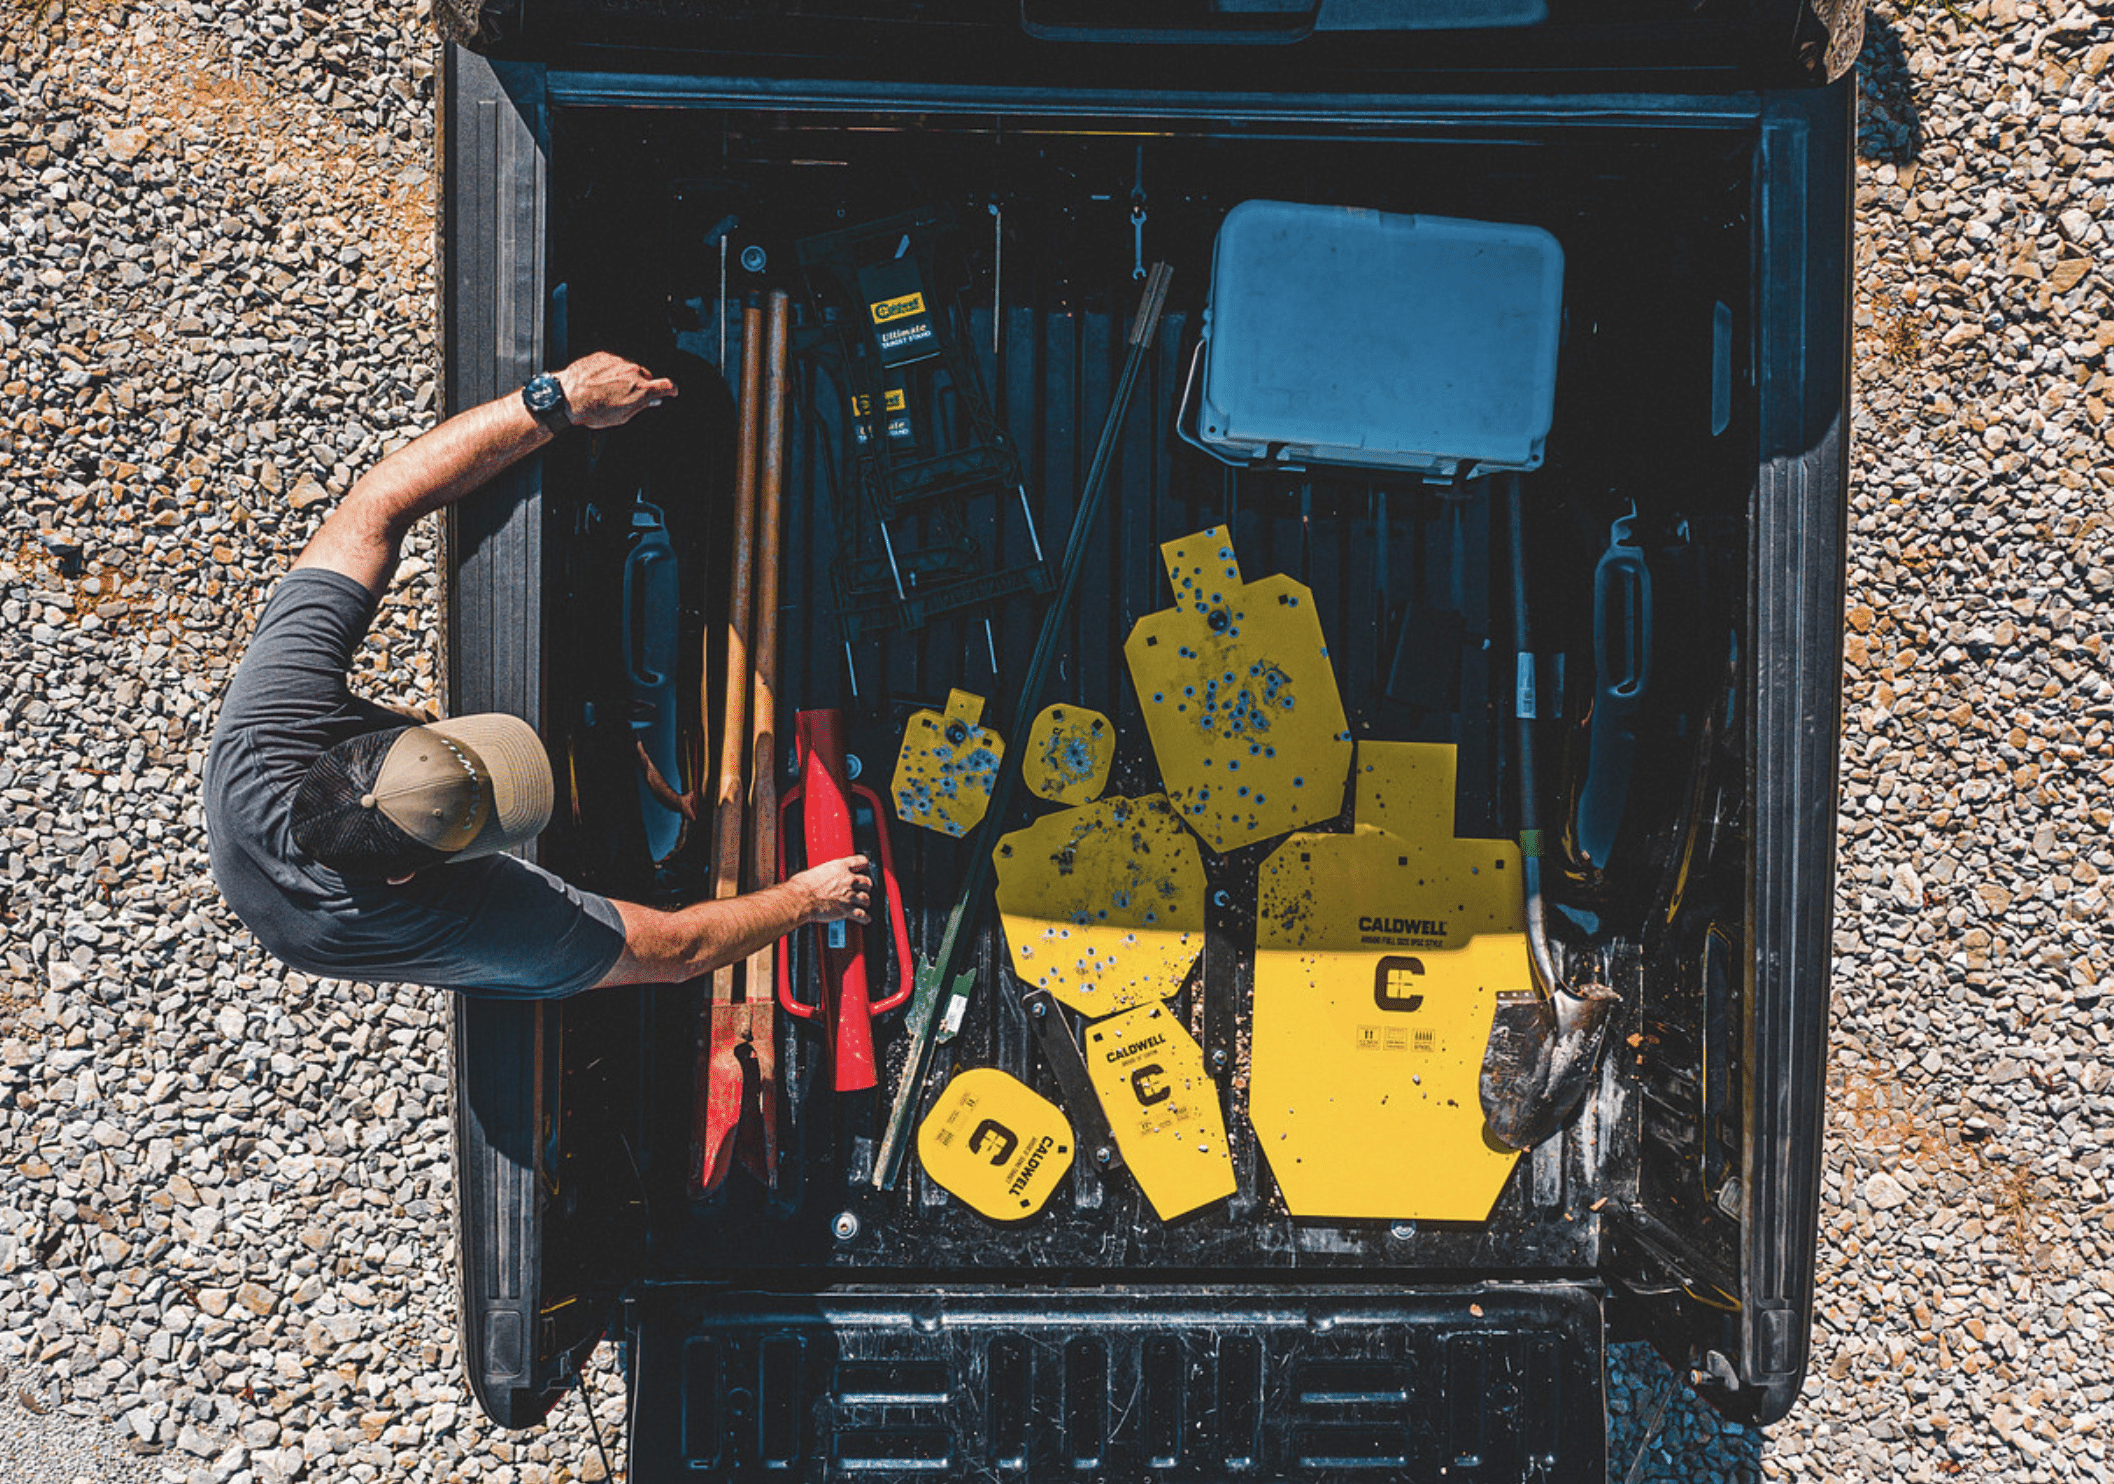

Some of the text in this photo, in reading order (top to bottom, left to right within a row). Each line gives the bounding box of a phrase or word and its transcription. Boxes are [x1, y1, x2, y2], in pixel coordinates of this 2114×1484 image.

[1359, 916, 1447, 936] CALDWELL
[1106, 1034, 1166, 1063] CALDWELL
[1008, 1136, 1054, 1196] CALDWELL
